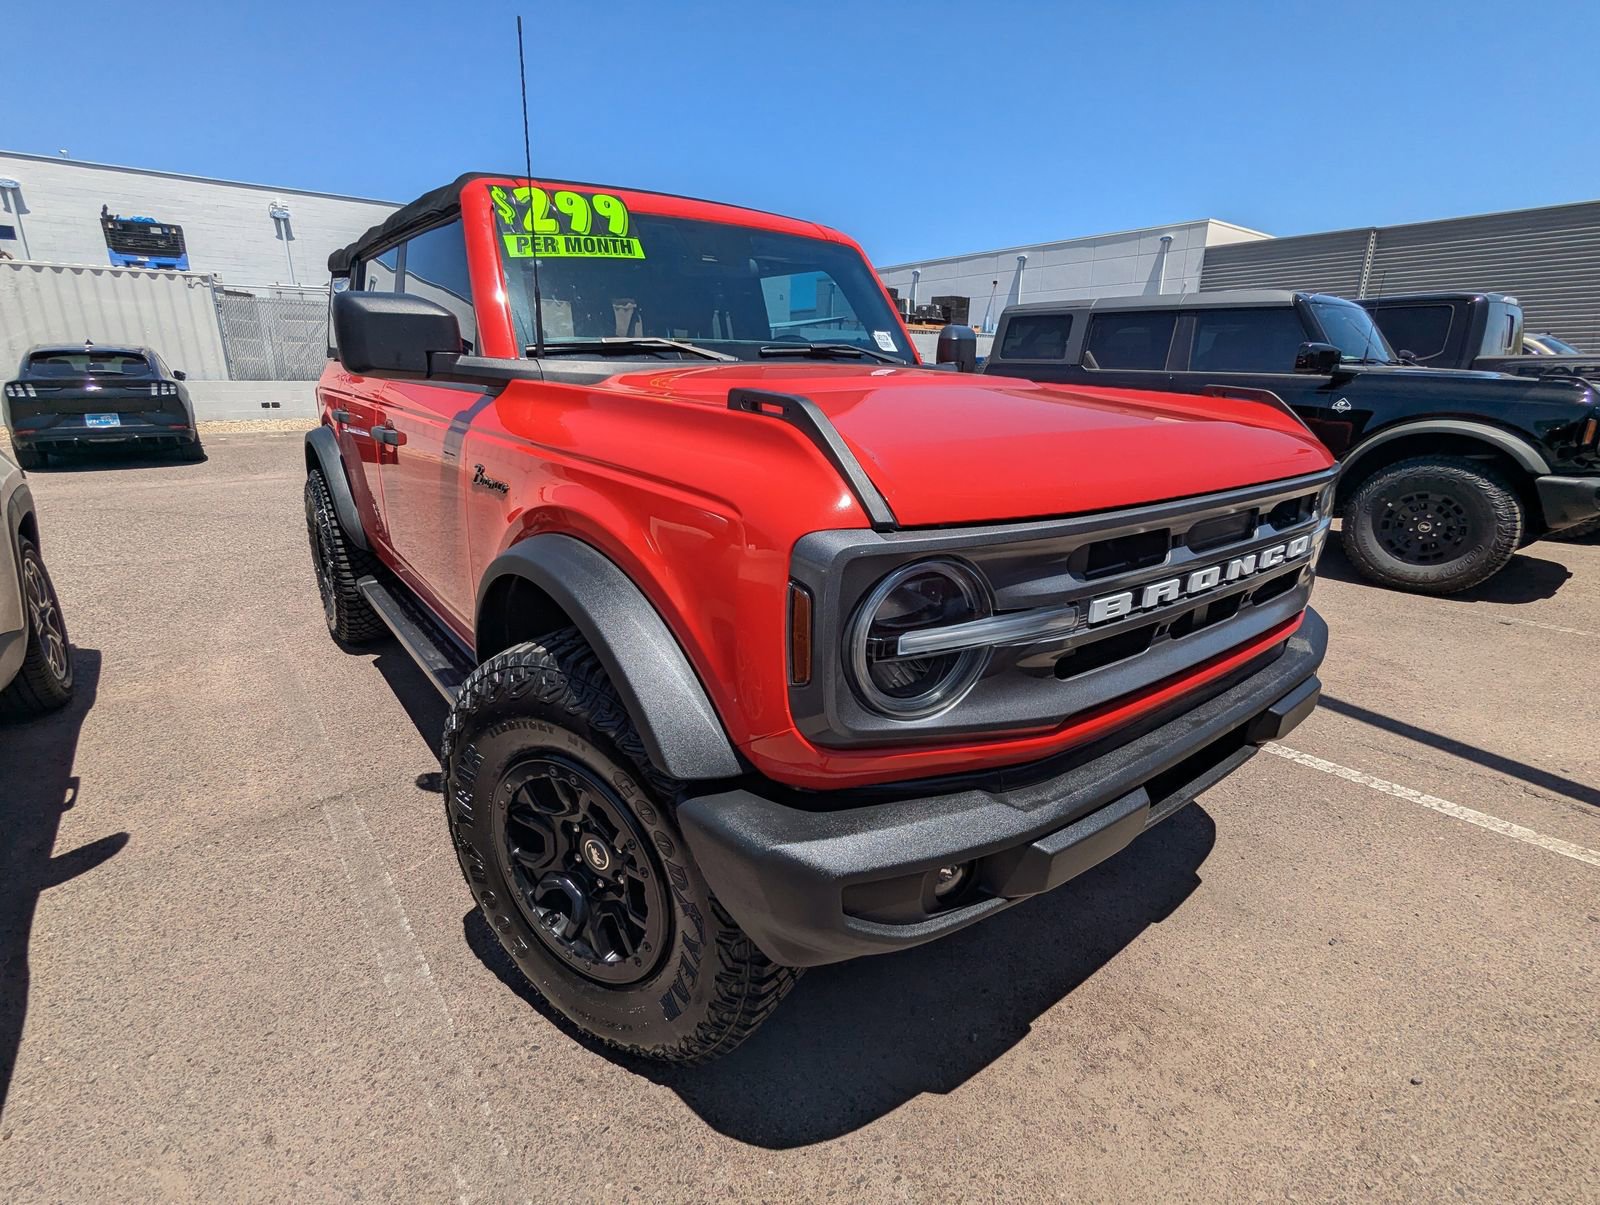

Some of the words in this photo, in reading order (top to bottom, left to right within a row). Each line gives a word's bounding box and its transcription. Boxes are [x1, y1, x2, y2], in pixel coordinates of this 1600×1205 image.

[490, 185, 630, 237] $299
[516, 236, 560, 255] PER
[564, 238, 635, 256] MONTH
[1088, 535, 1310, 624] BRONCO
